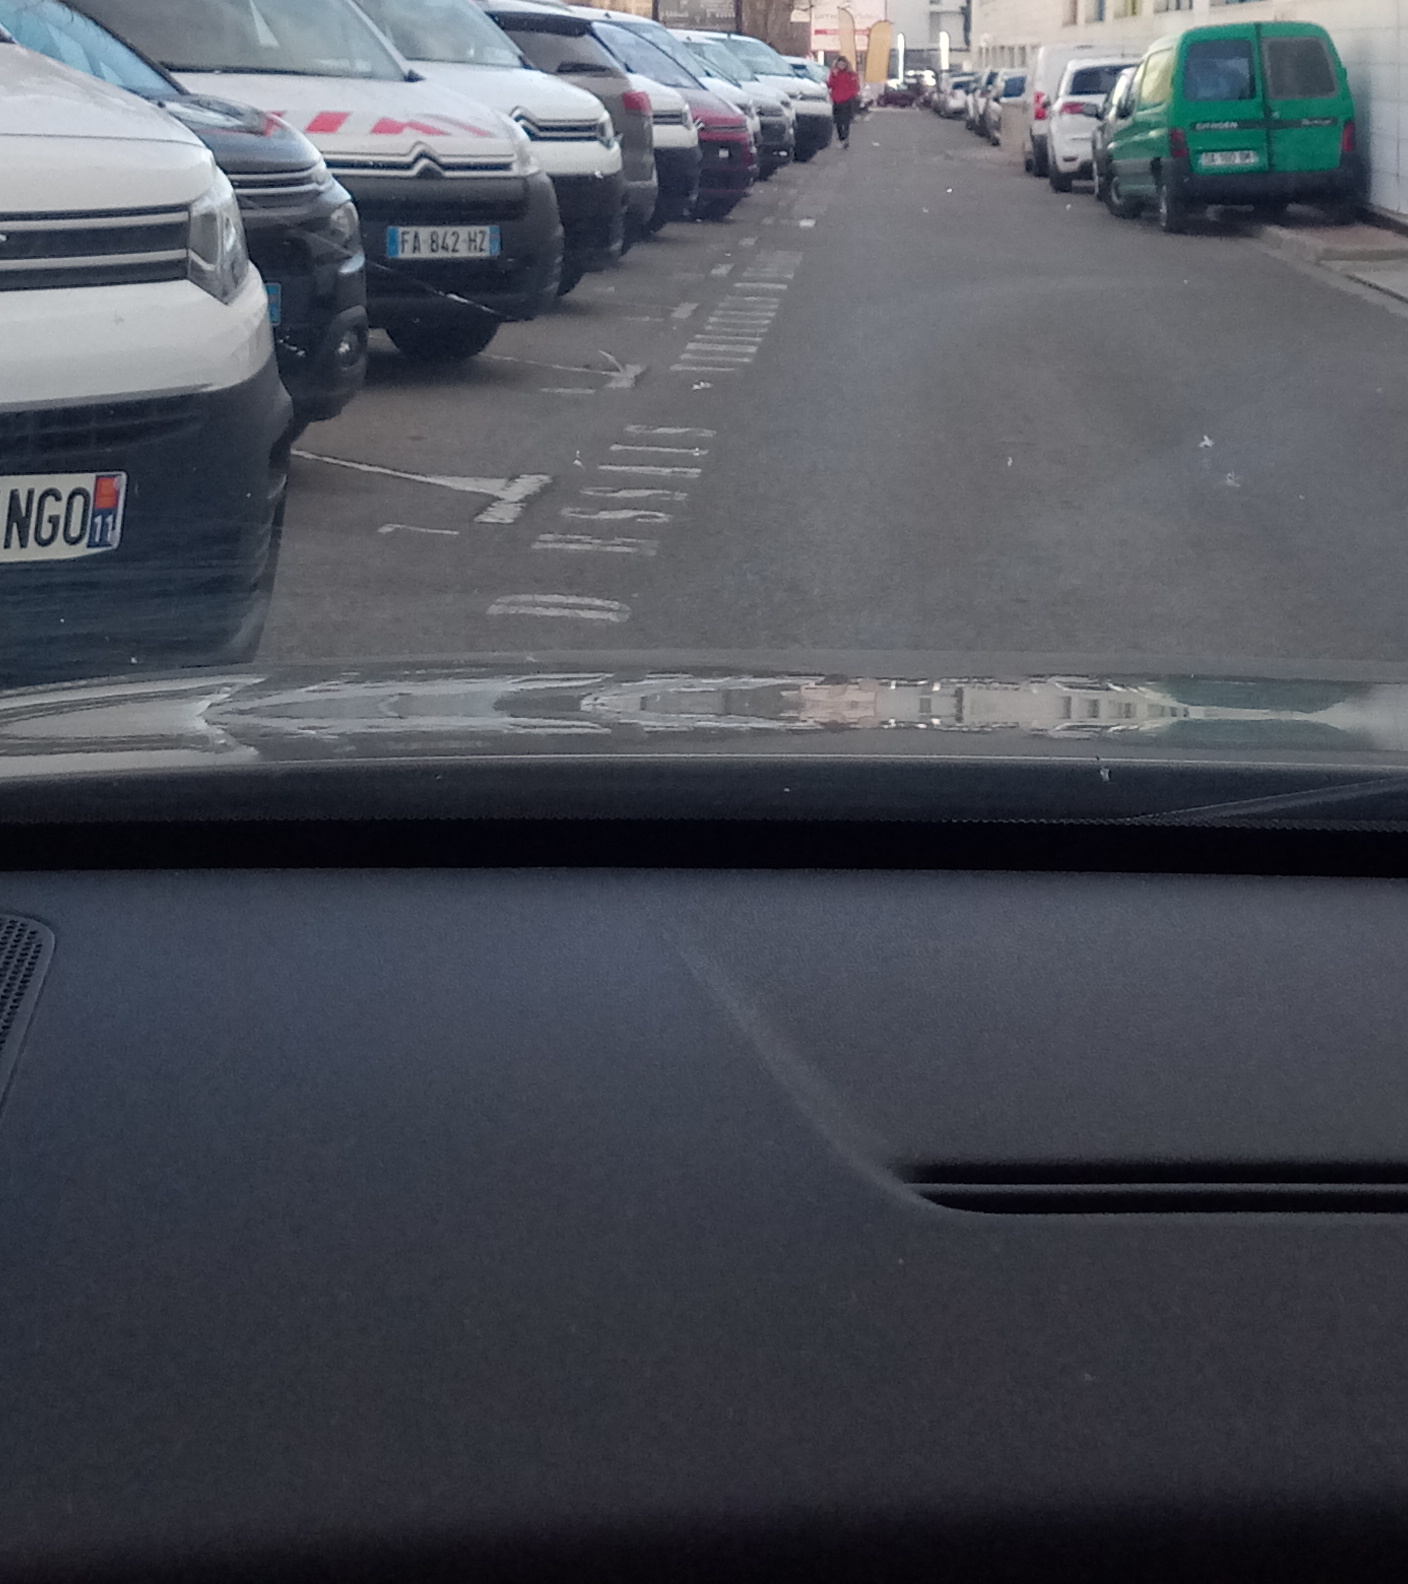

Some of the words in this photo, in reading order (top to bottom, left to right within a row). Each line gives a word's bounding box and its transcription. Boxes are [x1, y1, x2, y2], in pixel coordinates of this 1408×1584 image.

[401, 230, 421, 253] FA
[430, 230, 460, 253] 842
[468, 230, 487, 252] HZ
